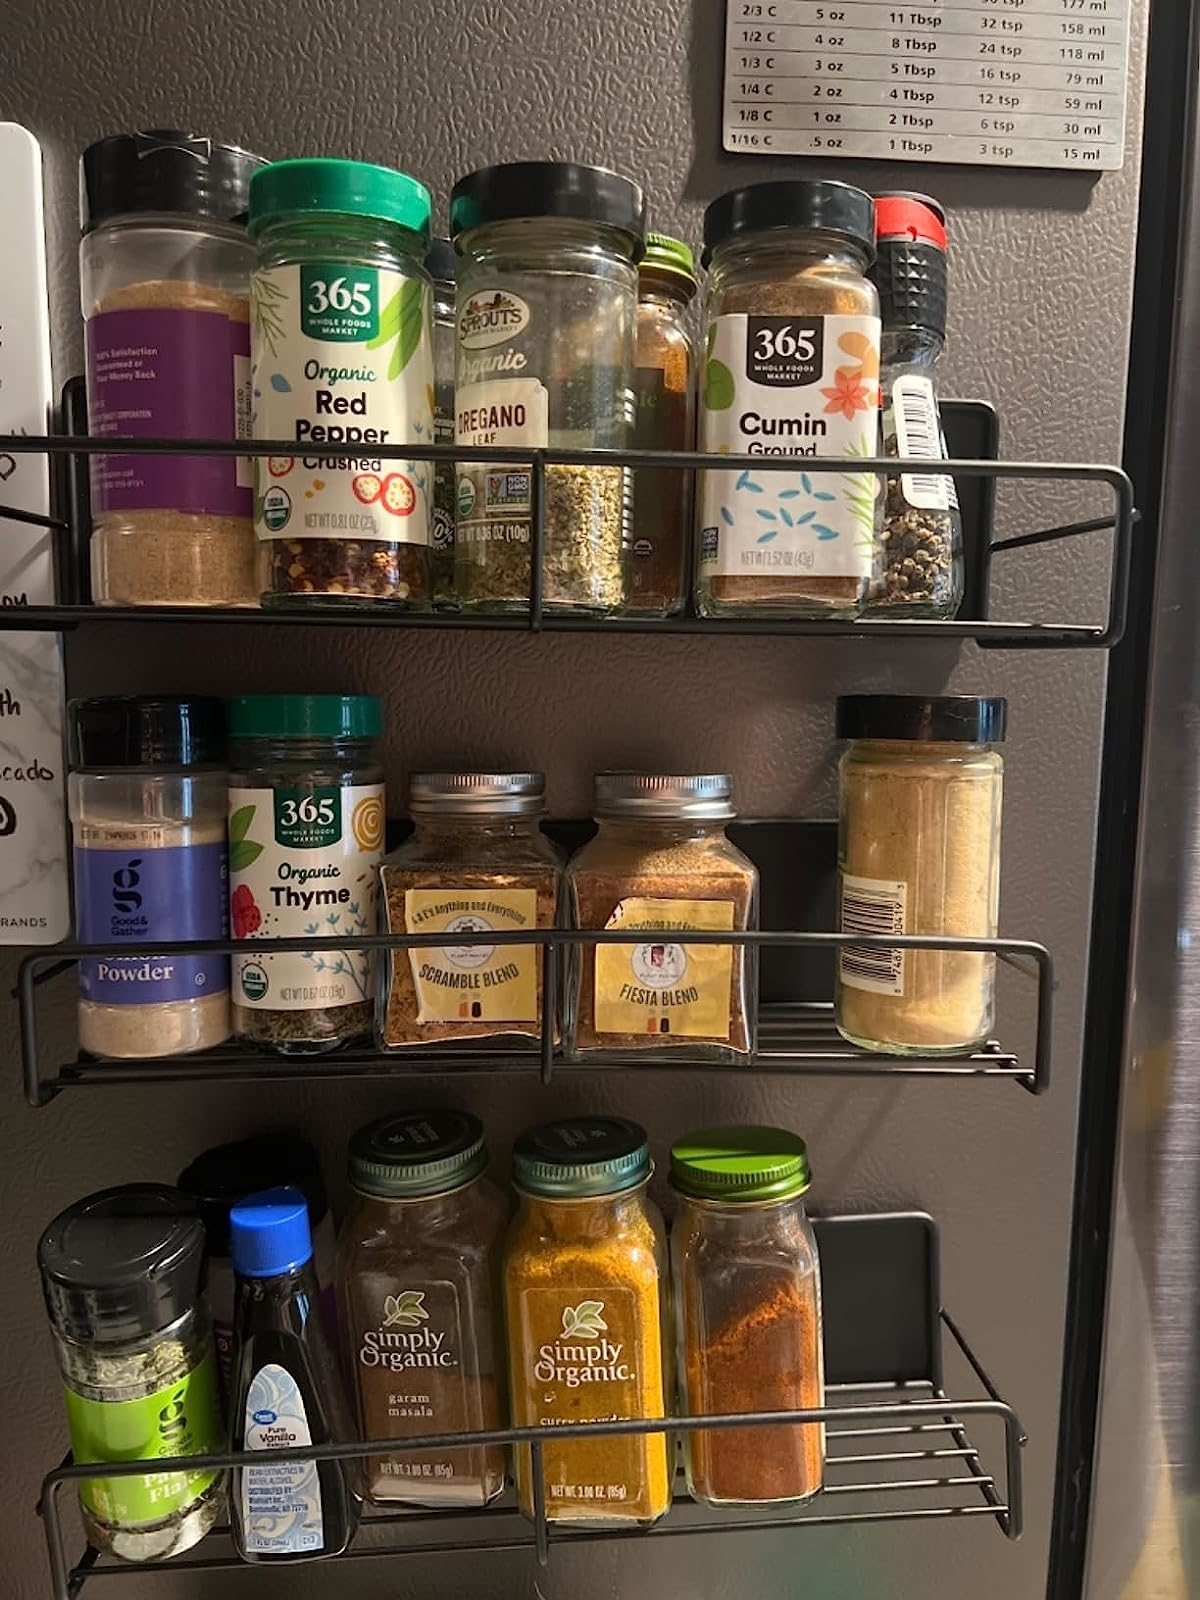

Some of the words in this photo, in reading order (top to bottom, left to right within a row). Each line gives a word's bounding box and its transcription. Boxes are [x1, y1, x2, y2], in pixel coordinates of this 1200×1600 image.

[742, 4, 763, 18] 2/3
[766, 5, 778, 18] C
[1089, 0, 1108, 11] ml
[815, 8, 825, 20] 5
[828, 11, 846, 22] oz
[889, 11, 905, 25] 11
[909, 12, 943, 28] Tbsp
[980, 17, 997, 30] 32
[1001, 19, 1024, 33] tsp
[1060, 23, 1085, 36] 158
[1088, 25, 1106, 37] ml
[742, 30, 763, 43] 1/2
[766, 30, 777, 44] C
[814, 34, 824, 45] 4
[827, 37, 845, 47] oz
[891, 37, 901, 50] 8
[905, 38, 938, 54] Tbsp
[979, 42, 997, 54] 24
[1000, 44, 1023, 58] tsp
[1059, 48, 1084, 61] 118
[1087, 49, 1105, 62] ml
[740, 56, 761, 70] 1/3
[765, 57, 776, 70] C
[814, 59, 824, 71] 3
[826, 62, 844, 72] oz
[891, 62, 900, 75] 5
[903, 63, 937, 78] Tbsp
[979, 68, 996, 80] 16
[999, 69, 1022, 83] tsp
[1065, 73, 1083, 85] 79
[1085, 74, 1104, 86] ml
[739, 83, 760, 96] 1/4
[764, 83, 775, 96] C
[812, 85, 822, 97] 2
[826, 88, 843, 98] oz
[889, 88, 899, 101] 4
[902, 89, 936, 105] Tbsp
[977, 92, 995, 106] 12
[998, 95, 1021, 109] tsp
[1064, 97, 1081, 110] 59
[1084, 98, 1103, 112] ml
[738, 109, 760, 123] 1/8
[762, 109, 774, 123] C
[813, 111, 821, 123] 1
[824, 114, 842, 124] oz
[888, 113, 898, 126] 2
[901, 114, 935, 131] Tbsp
[980, 118, 990, 130] 6
[993, 119, 1016, 133] tsp
[1063, 122, 1080, 135] 30
[1083, 124, 1102, 137] ml
[730, 134, 760, 147] 1/16
[763, 134, 774, 147] C
[808, 136, 822, 148] .5
[826, 139, 843, 149] oz
[888, 139, 896, 151] 1
[900, 140, 934, 154] Tbsp
[978, 144, 989, 156] 3
[991, 145, 1014, 159] tsp
[1063, 148, 1079, 160] 15
[1082, 150, 1101, 161] ml
[308, 277, 371, 315] 365
[309, 318, 339, 326] WHOLE
[342, 319, 371, 328] FOODS
[460, 308, 522, 341] SPROUTS
[322, 328, 358, 336] MARKET
[753, 325, 818, 361] 365
[304, 359, 376, 386] Organic
[754, 364, 784, 373] WHOLE
[786, 365, 815, 373] FOODS
[767, 373, 802, 381] MARKET
[315, 390, 367, 415] Red
[295, 419, 390, 444] Pepper
[739, 412, 827, 436] Cumin
[473, 432, 497, 446] LEAF
[747, 441, 817, 457] Ground
[507, 475, 527, 483] NON
[507, 482, 528, 490] GMO
[506, 523, 530, 543] (10g)
[281, 795, 335, 826] 365
[278, 862, 341, 884] Organic
[270, 885, 351, 912] Thyme
[434, 901, 470, 915] Anything
[471, 902, 486, 911] and
[486, 902, 527, 926] Everything
[98, 964, 173, 981] Powder
[418, 963, 481, 989] SCRAMBLE
[482, 962, 519, 988] BLEND
[619, 983, 658, 1006] FIESTA
[661, 986, 699, 1006] BLEND
[364, 1327, 444, 1352] Simply
[539, 1338, 623, 1365] Simply
[388, 1393, 430, 1404] garam
[388, 1405, 433, 1417] masala
[260, 1433, 296, 1442] Vanilla
[380, 1463, 392, 1474] NET
[393, 1463, 404, 1475] WT.
[551, 1484, 564, 1497] NET
[565, 1485, 577, 1498] WT.
[578, 1485, 594, 1498] 3.00
